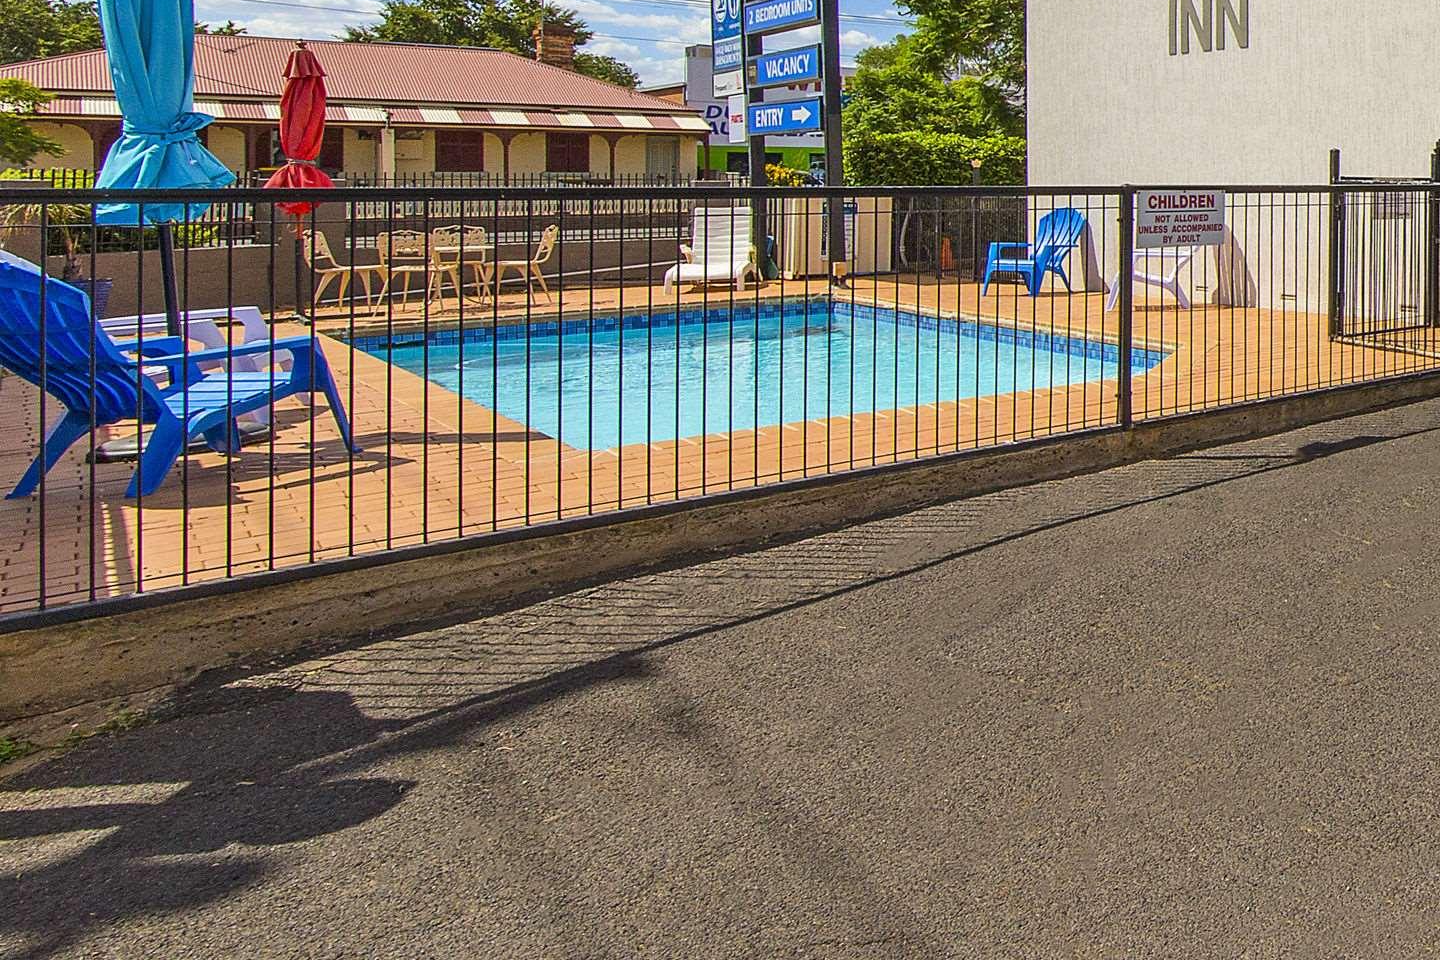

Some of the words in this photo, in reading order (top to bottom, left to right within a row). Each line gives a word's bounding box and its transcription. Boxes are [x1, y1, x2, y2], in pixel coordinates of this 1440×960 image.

[749, 10, 754, 25] 2
[755, 1, 791, 23] BEDROOM
[766, 54, 810, 78] VACANCY
[755, 108, 784, 128] ENTRY
[1148, 195, 1215, 209] CHILDREN
[1155, 215, 1170, 223] NOT
[1174, 214, 1209, 222] ALLOWED
[1138, 226, 1168, 234] UNLESS
[1172, 223, 1223, 233] ACCOMPANIED
[1162, 235, 1174, 244] BY
[1176, 234, 1201, 243] ADULT
